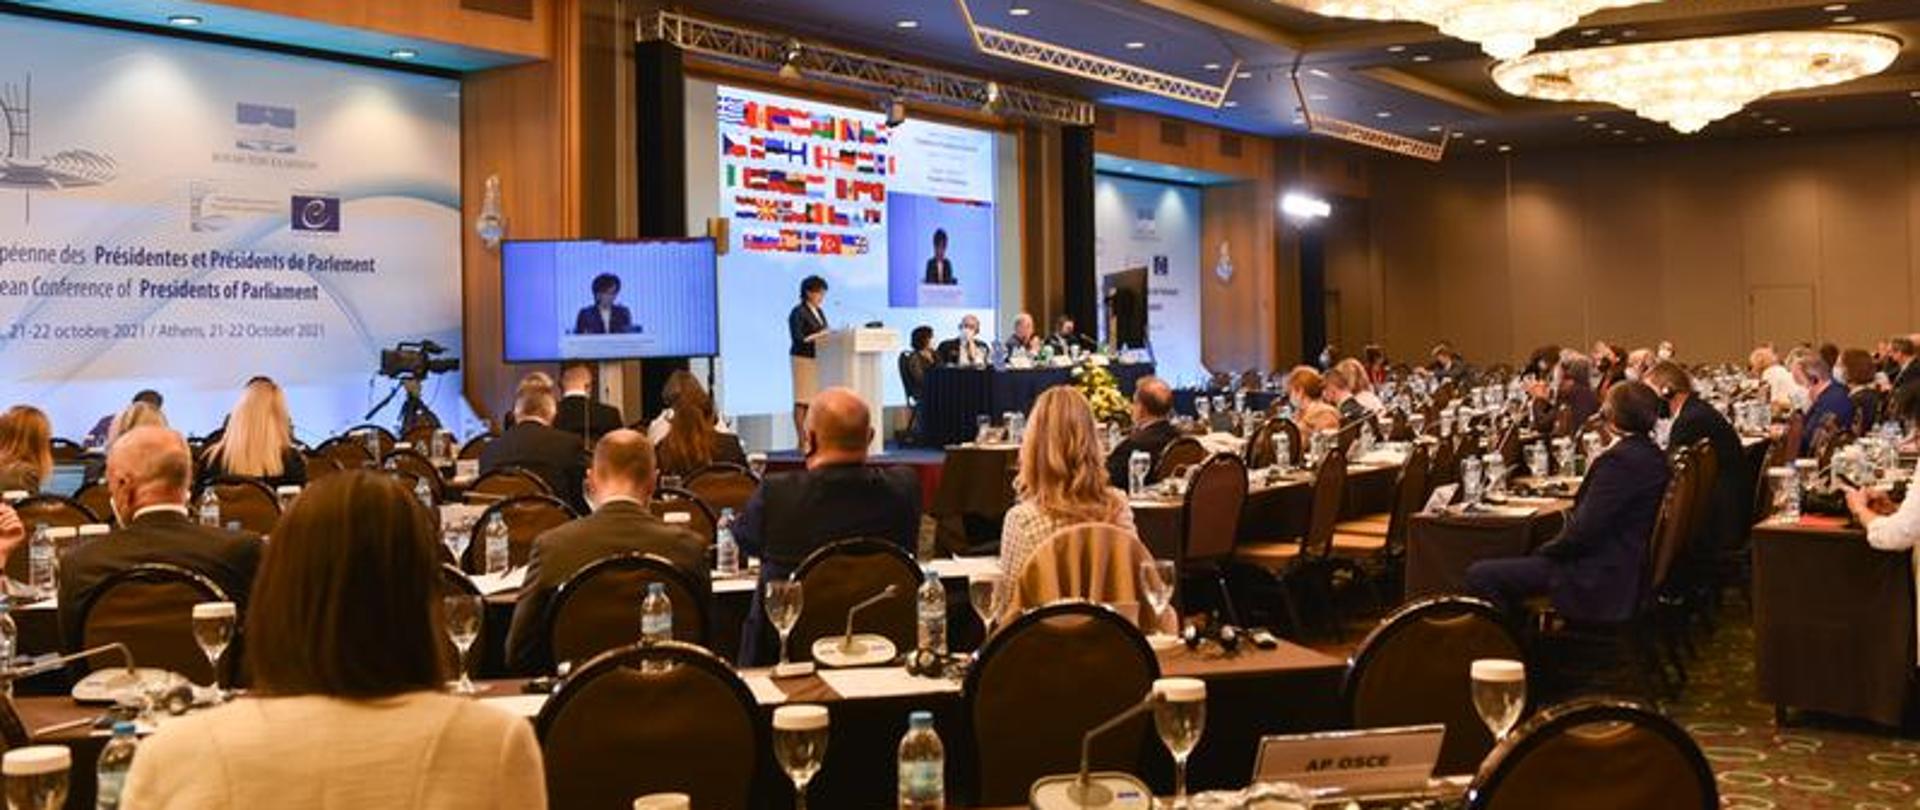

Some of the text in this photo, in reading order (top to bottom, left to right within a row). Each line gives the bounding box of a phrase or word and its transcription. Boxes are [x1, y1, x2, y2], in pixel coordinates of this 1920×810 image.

[60, 245, 86, 265] des
[95, 246, 188, 267] Présidentes
[191, 252, 207, 268] et
[210, 250, 284, 270] Présidents
[288, 253, 304, 270] de
[307, 254, 376, 273] Parlement
[0, 276, 319, 301] ean Conference of Presidents of Parliament
[8, 323, 50, 339] 21-22
[54, 323, 110, 339] octobre
[114, 323, 146, 339] 2021
[209, 323, 244, 338] 21-22
[247, 323, 295, 338] October
[298, 323, 325, 338] 2021
[1306, 755, 1391, 772] AP OSCE
